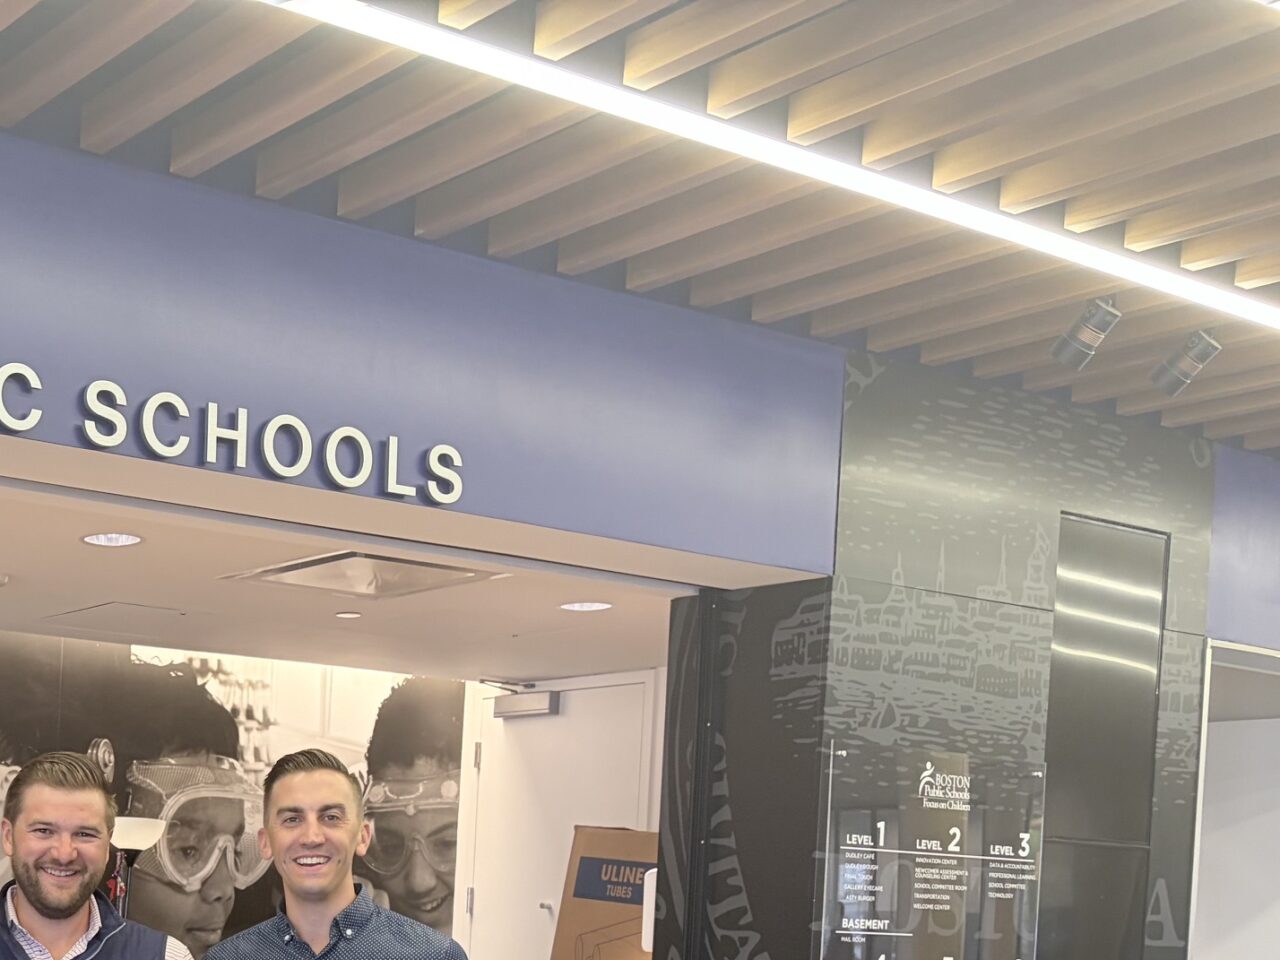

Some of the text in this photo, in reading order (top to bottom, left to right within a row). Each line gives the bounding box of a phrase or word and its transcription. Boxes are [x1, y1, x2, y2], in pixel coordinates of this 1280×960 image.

[79, 379, 464, 505] SCHOOLS
[936, 773, 970, 791] BOSTON
[924, 784, 970, 800] Public Schools
[947, 800, 970, 811] Children
[846, 821, 885, 846] LEVEL 1
[916, 827, 960, 852] LEVEL 2
[990, 833, 1030, 857] LEVEL 3
[601, 864, 644, 884] ULINE
[606, 884, 632, 898] TUBES
[842, 918, 890, 930] BASEMENT
